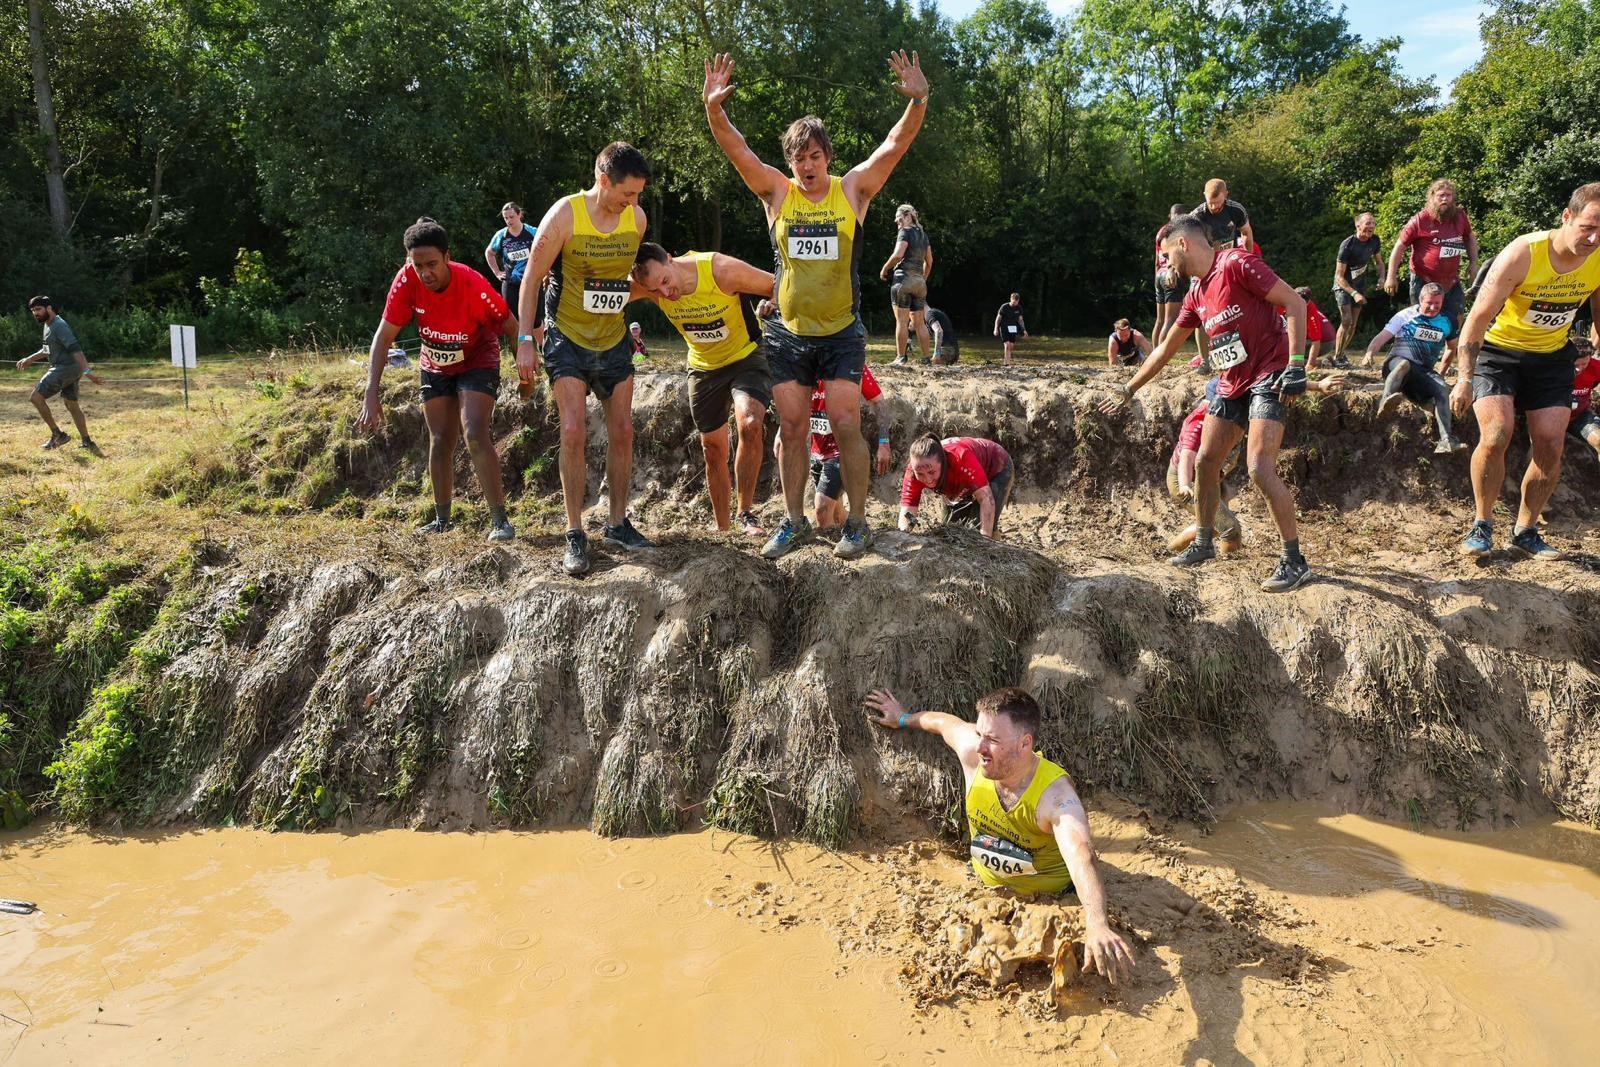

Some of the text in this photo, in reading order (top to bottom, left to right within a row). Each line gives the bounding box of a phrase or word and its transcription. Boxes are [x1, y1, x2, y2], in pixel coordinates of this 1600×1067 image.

[796, 240, 828, 255] 2961
[1549, 282, 1577, 290] running
[1520, 290, 1537, 298] Beat
[591, 293, 624, 310] 2969
[1532, 313, 1569, 327] 2965
[422, 326, 469, 341] dynamic
[693, 330, 723, 339] 3004
[1418, 329, 1439, 340] 2963
[427, 350, 457, 363] 2992
[975, 809, 989, 821] I'm
[989, 819, 1020, 840] running
[980, 853, 1024, 874] 2964
